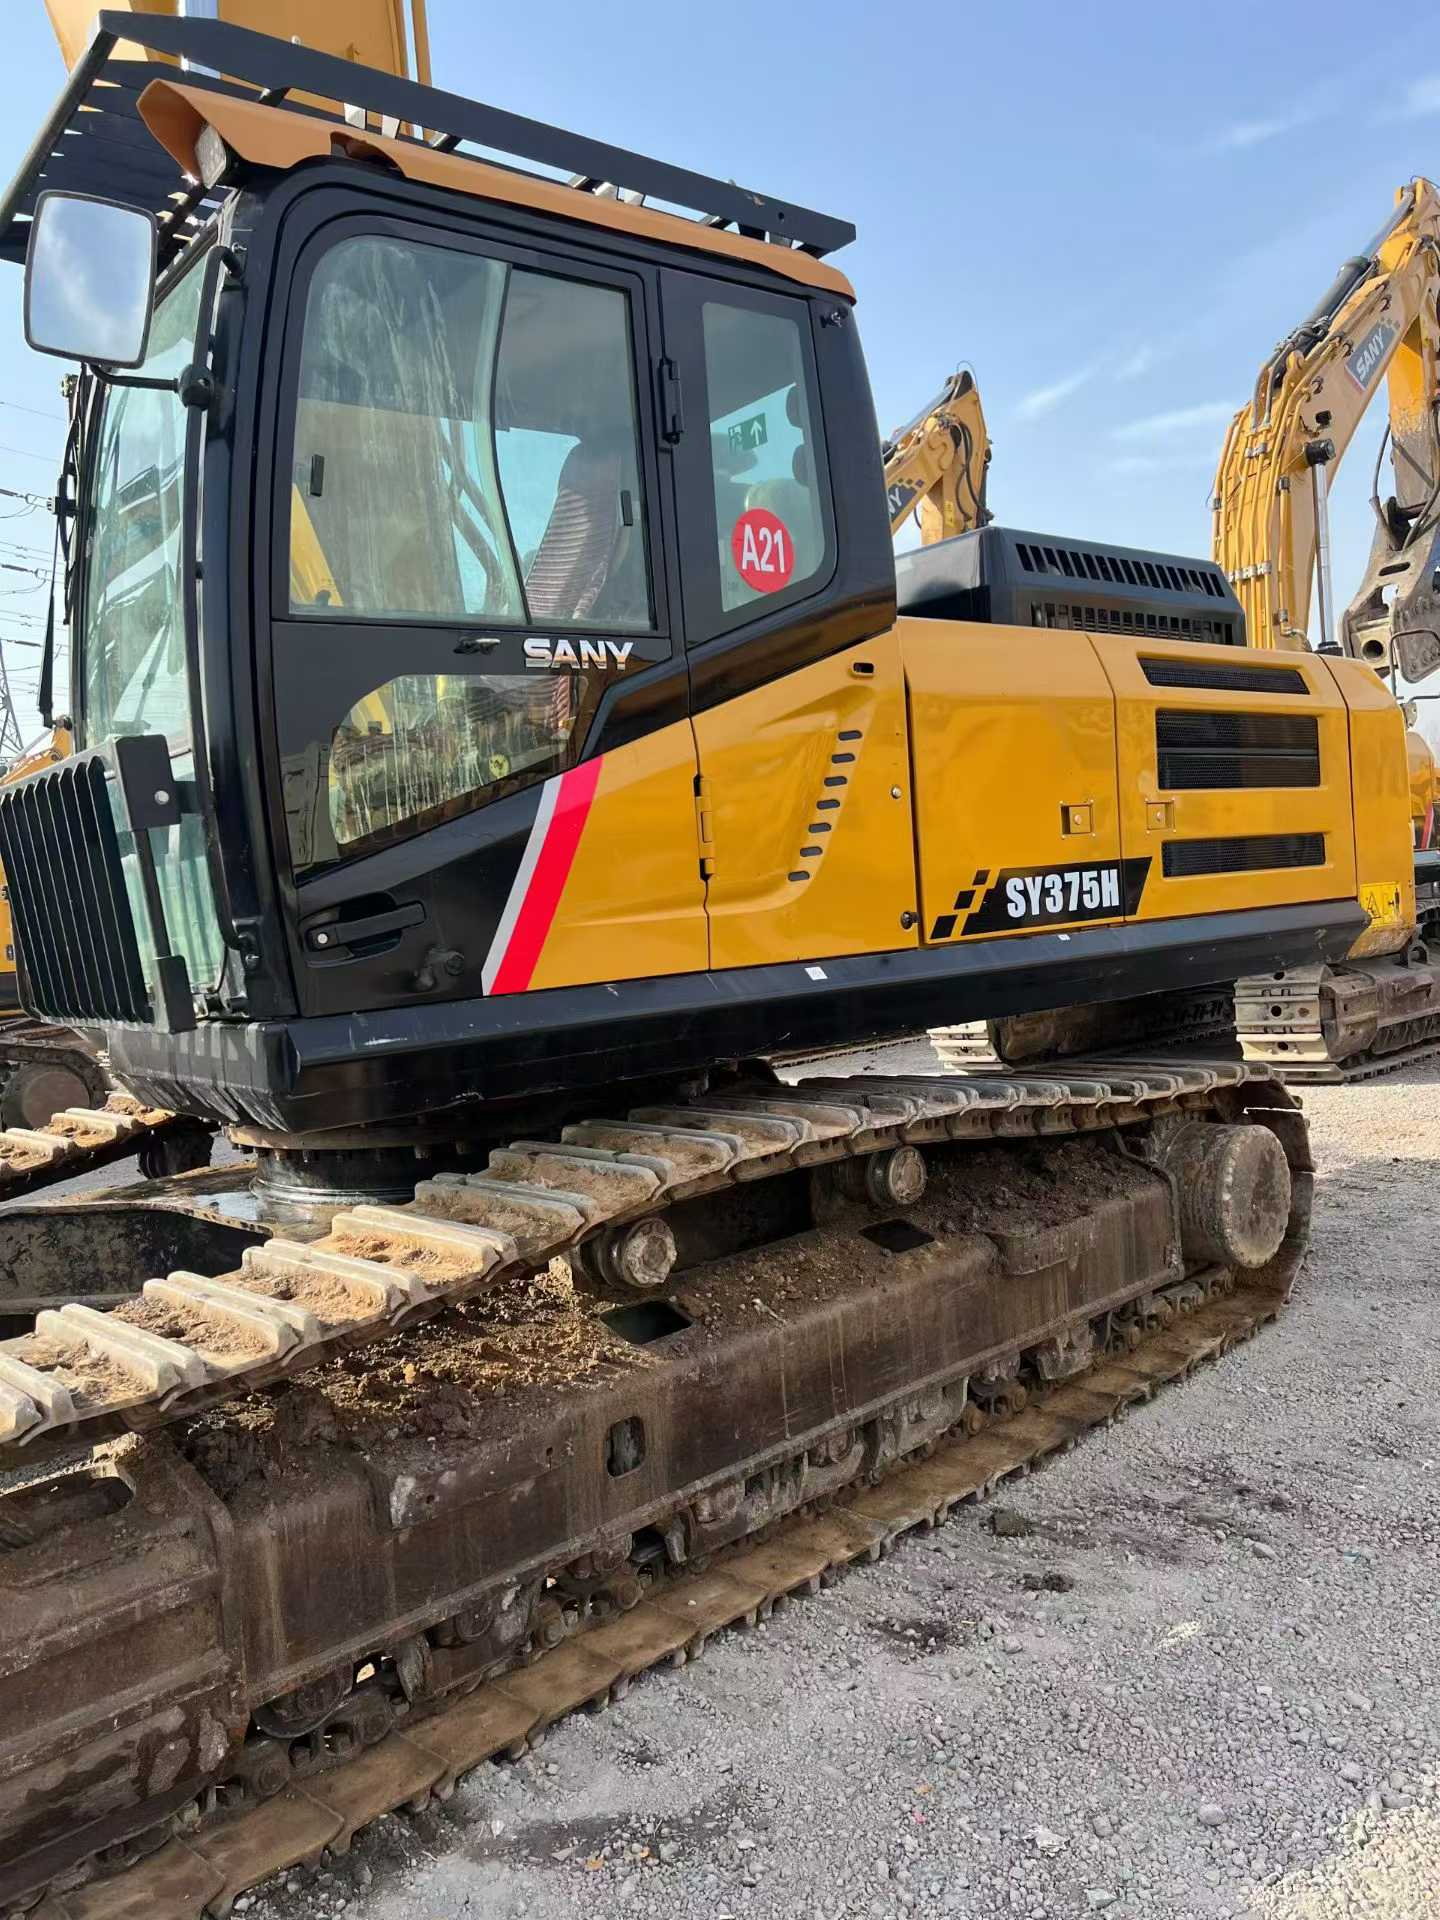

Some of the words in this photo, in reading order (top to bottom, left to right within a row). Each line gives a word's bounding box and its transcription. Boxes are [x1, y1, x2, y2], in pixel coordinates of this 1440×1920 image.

[1356, 327, 1384, 381] SANY
[742, 523, 785, 573] A21
[523, 638, 634, 670] SANY
[1005, 868, 1120, 918] SY375H
